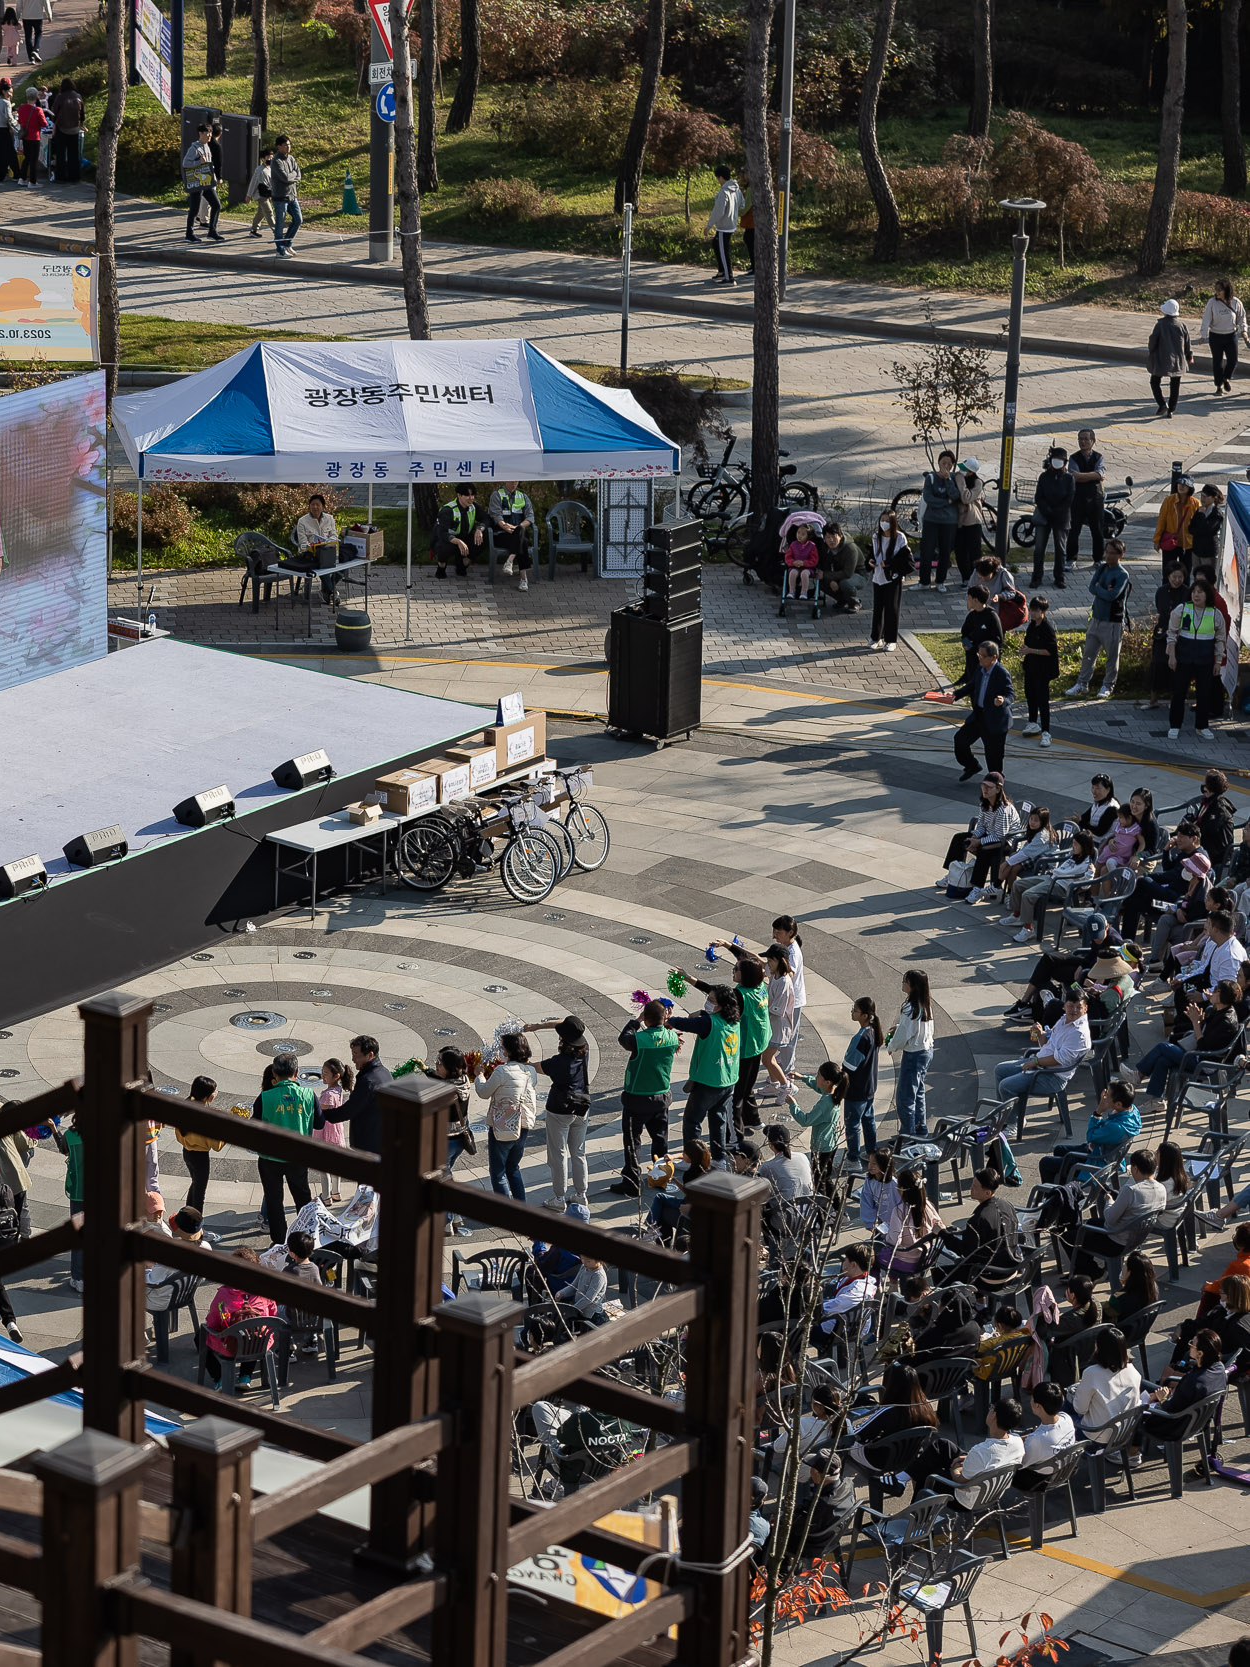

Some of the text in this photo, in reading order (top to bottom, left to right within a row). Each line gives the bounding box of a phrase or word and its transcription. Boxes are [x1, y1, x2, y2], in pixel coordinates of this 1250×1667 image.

[304, 382, 495, 408] 광장동주민센터
[324, 460, 496, 478] 광장동 주민센터
[275, 1104, 303, 1115] 새마을
[588, 1433, 628, 1447] NOCTA
